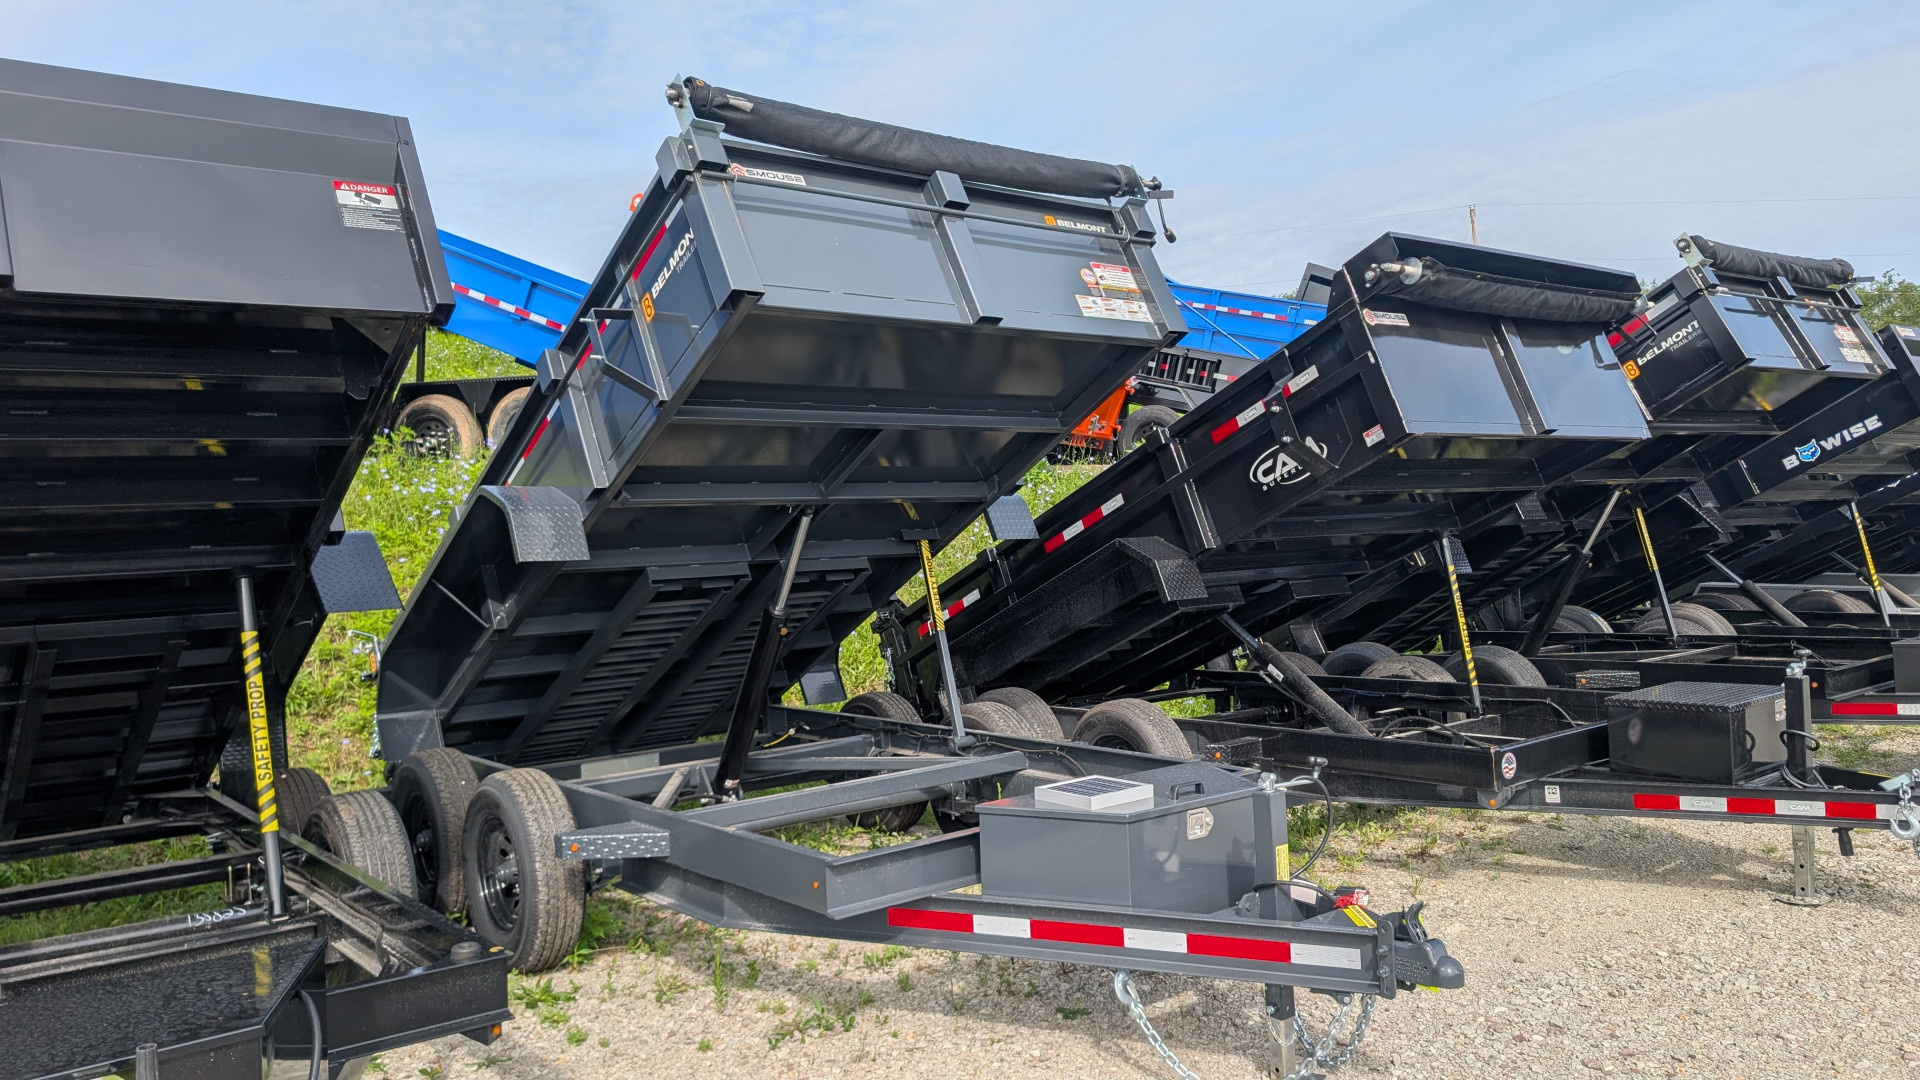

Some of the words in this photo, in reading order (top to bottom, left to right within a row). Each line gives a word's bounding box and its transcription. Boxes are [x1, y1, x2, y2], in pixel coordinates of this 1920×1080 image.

[349, 184, 389, 194] DANGER
[745, 168, 804, 184] SMOUSE
[1057, 219, 1106, 233] BELMONT
[651, 227, 695, 300] BELMON
[675, 239, 697, 275] TRAILE
[1636, 319, 1700, 367] BELMONT
[1669, 328, 1703, 353] TRAILERS
[925, 555, 936, 578] PROP
[929, 581, 941, 612] SAFETY
[1455, 594, 1465, 618] PROP
[1460, 620, 1472, 655] SAFETY
[248, 680, 266, 720] PROP
[253, 725, 272, 781] SAFETY
[1693, 799, 1714, 807] CAM
